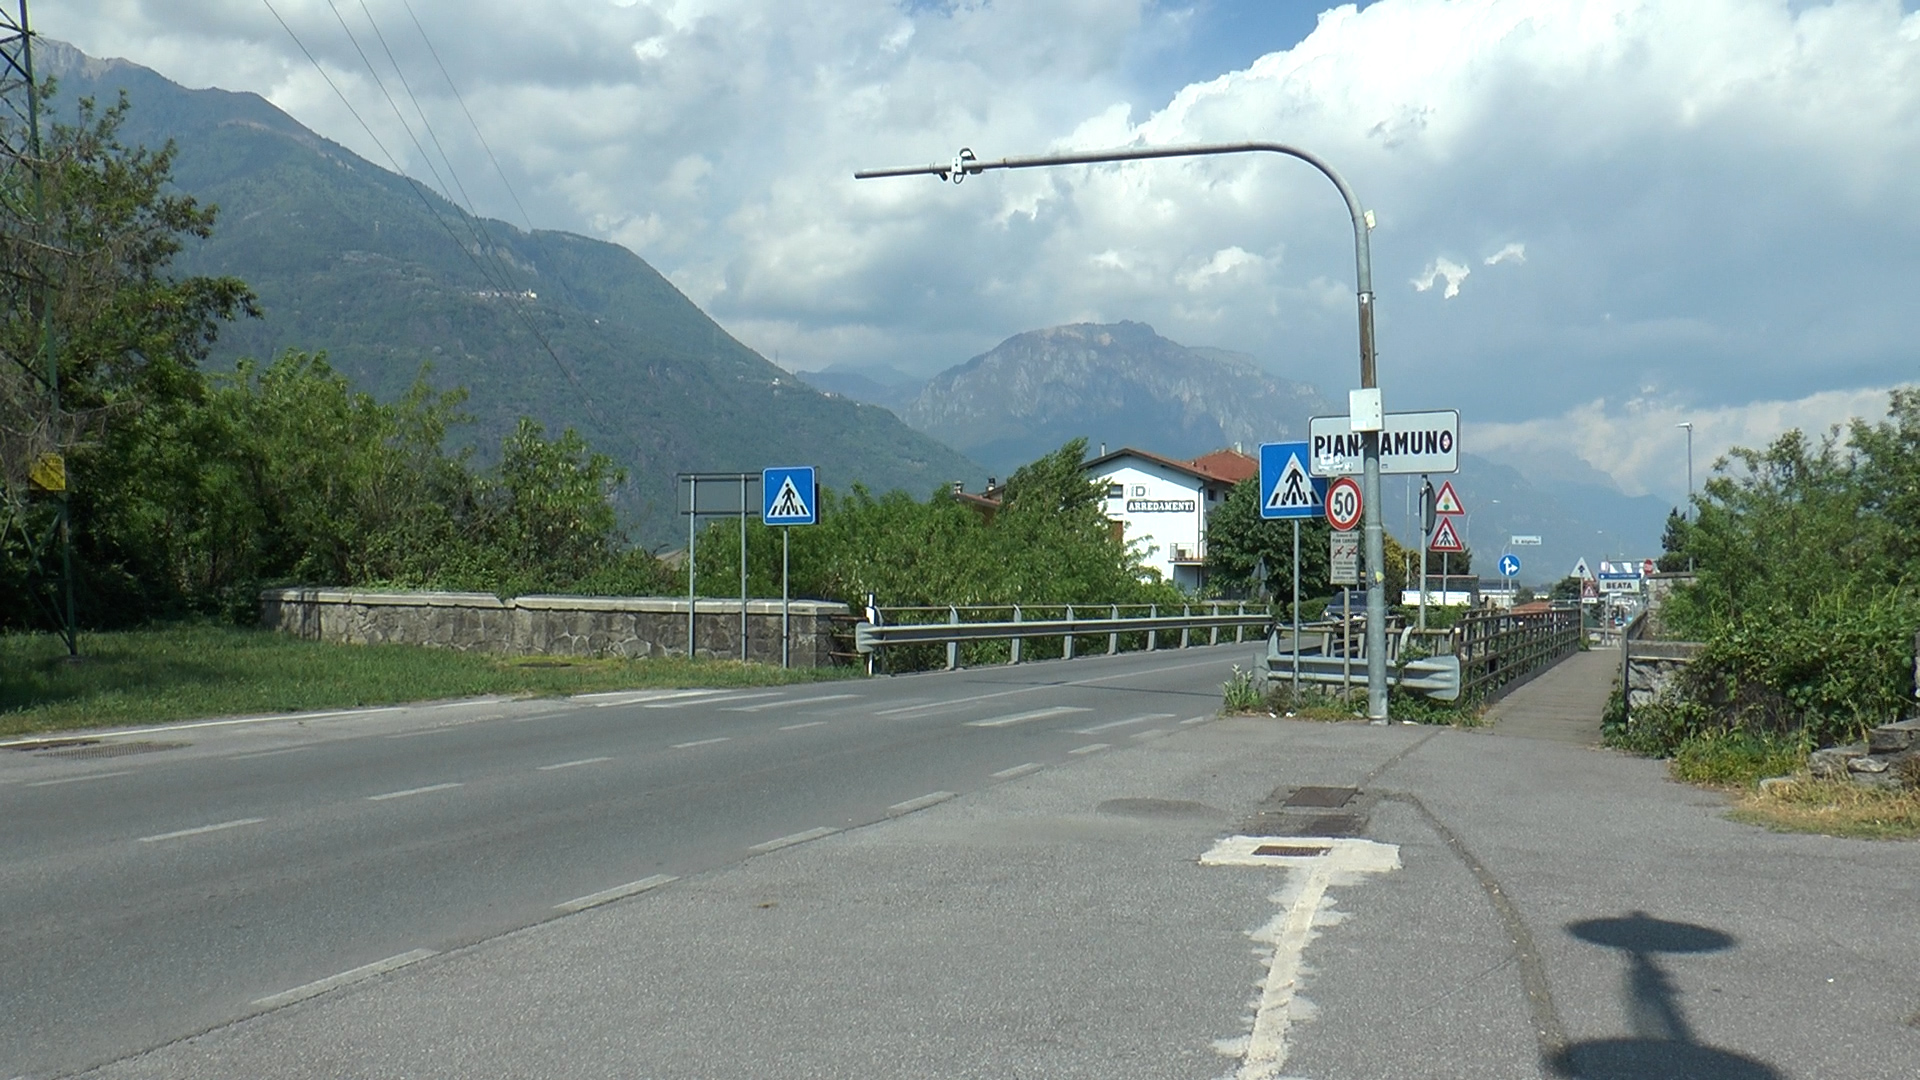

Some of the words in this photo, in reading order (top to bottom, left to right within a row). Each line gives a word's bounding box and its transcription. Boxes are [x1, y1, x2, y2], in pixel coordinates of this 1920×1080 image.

[1379, 430, 1453, 456] AMUNO
[1128, 501, 1194, 511] ARREDAMENTI
[1333, 491, 1355, 516] 50
